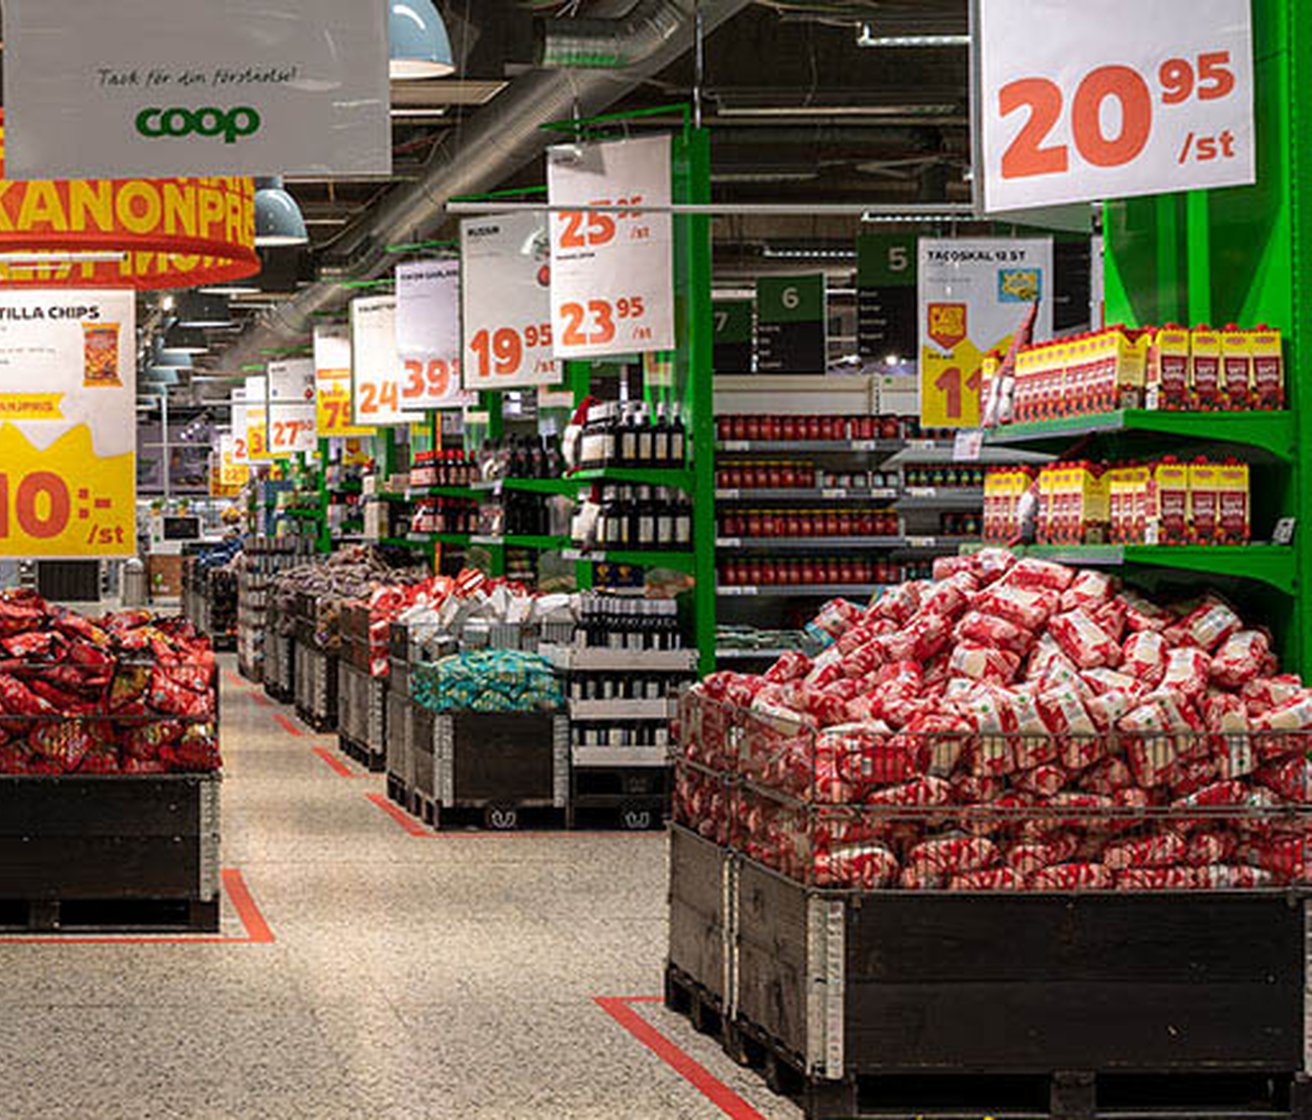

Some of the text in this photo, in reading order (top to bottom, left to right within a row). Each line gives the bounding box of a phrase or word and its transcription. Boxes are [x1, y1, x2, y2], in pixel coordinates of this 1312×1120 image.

[98, 68, 139, 86] Tack
[135, 107, 261, 144] coop
[998, 51, 1236, 179] 20 95
[1178, 130, 1235, 164] /st
[558, 200, 616, 248] 25
[889, 247, 909, 271] 5
[48, 306, 100, 320] CHIPS
[781, 287, 800, 309] 6
[559, 297, 645, 347] 23 95
[714, 312, 729, 332] 7
[470, 324, 553, 377] 19 95
[402, 358, 449, 398] 39
[359, 381, 397, 414] 24
[273, 421, 299, 446] 27
[87, 524, 124, 545] /st
